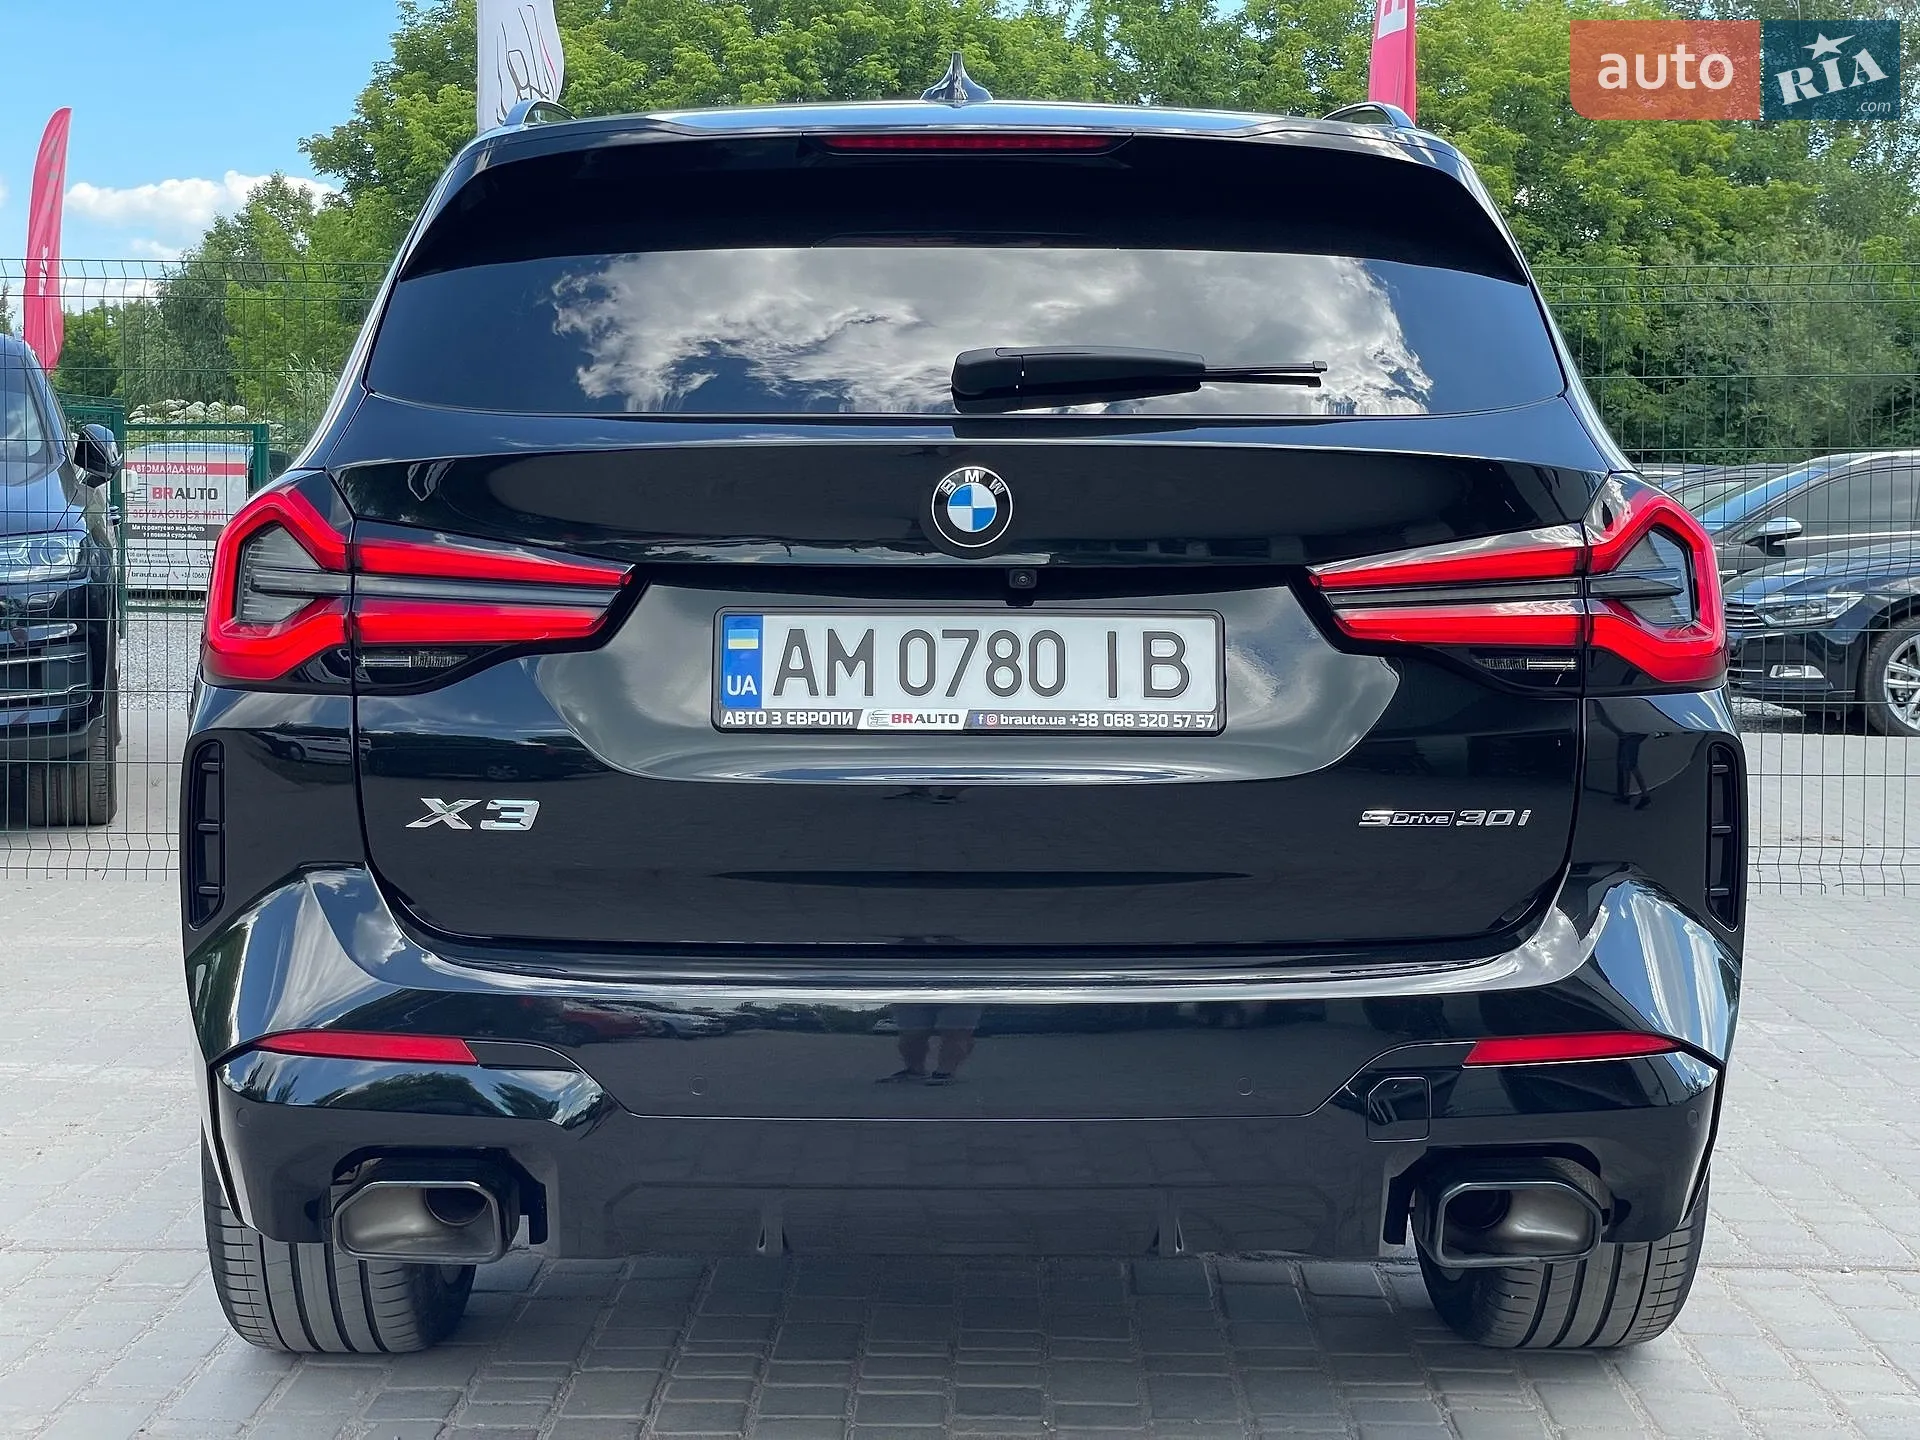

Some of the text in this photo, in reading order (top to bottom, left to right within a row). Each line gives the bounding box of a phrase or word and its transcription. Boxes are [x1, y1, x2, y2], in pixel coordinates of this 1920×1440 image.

[940, 469, 1006, 497] BMW
[152, 487, 219, 500] BRAUTO
[772, 628, 1191, 700] AM 0780 IB
[726, 676, 758, 696] UA
[722, 711, 767, 726] АВТО
[786, 711, 854, 727] ЄВРОПИ
[891, 713, 960, 725] BRAUTO
[1000, 713, 1066, 726] brauto.ua
[1069, 713, 1099, 727] +38
[1103, 714, 1135, 727] 068
[1138, 714, 1169, 728] 320
[405, 797, 540, 831] X3
[1455, 809, 1532, 827] 30i
